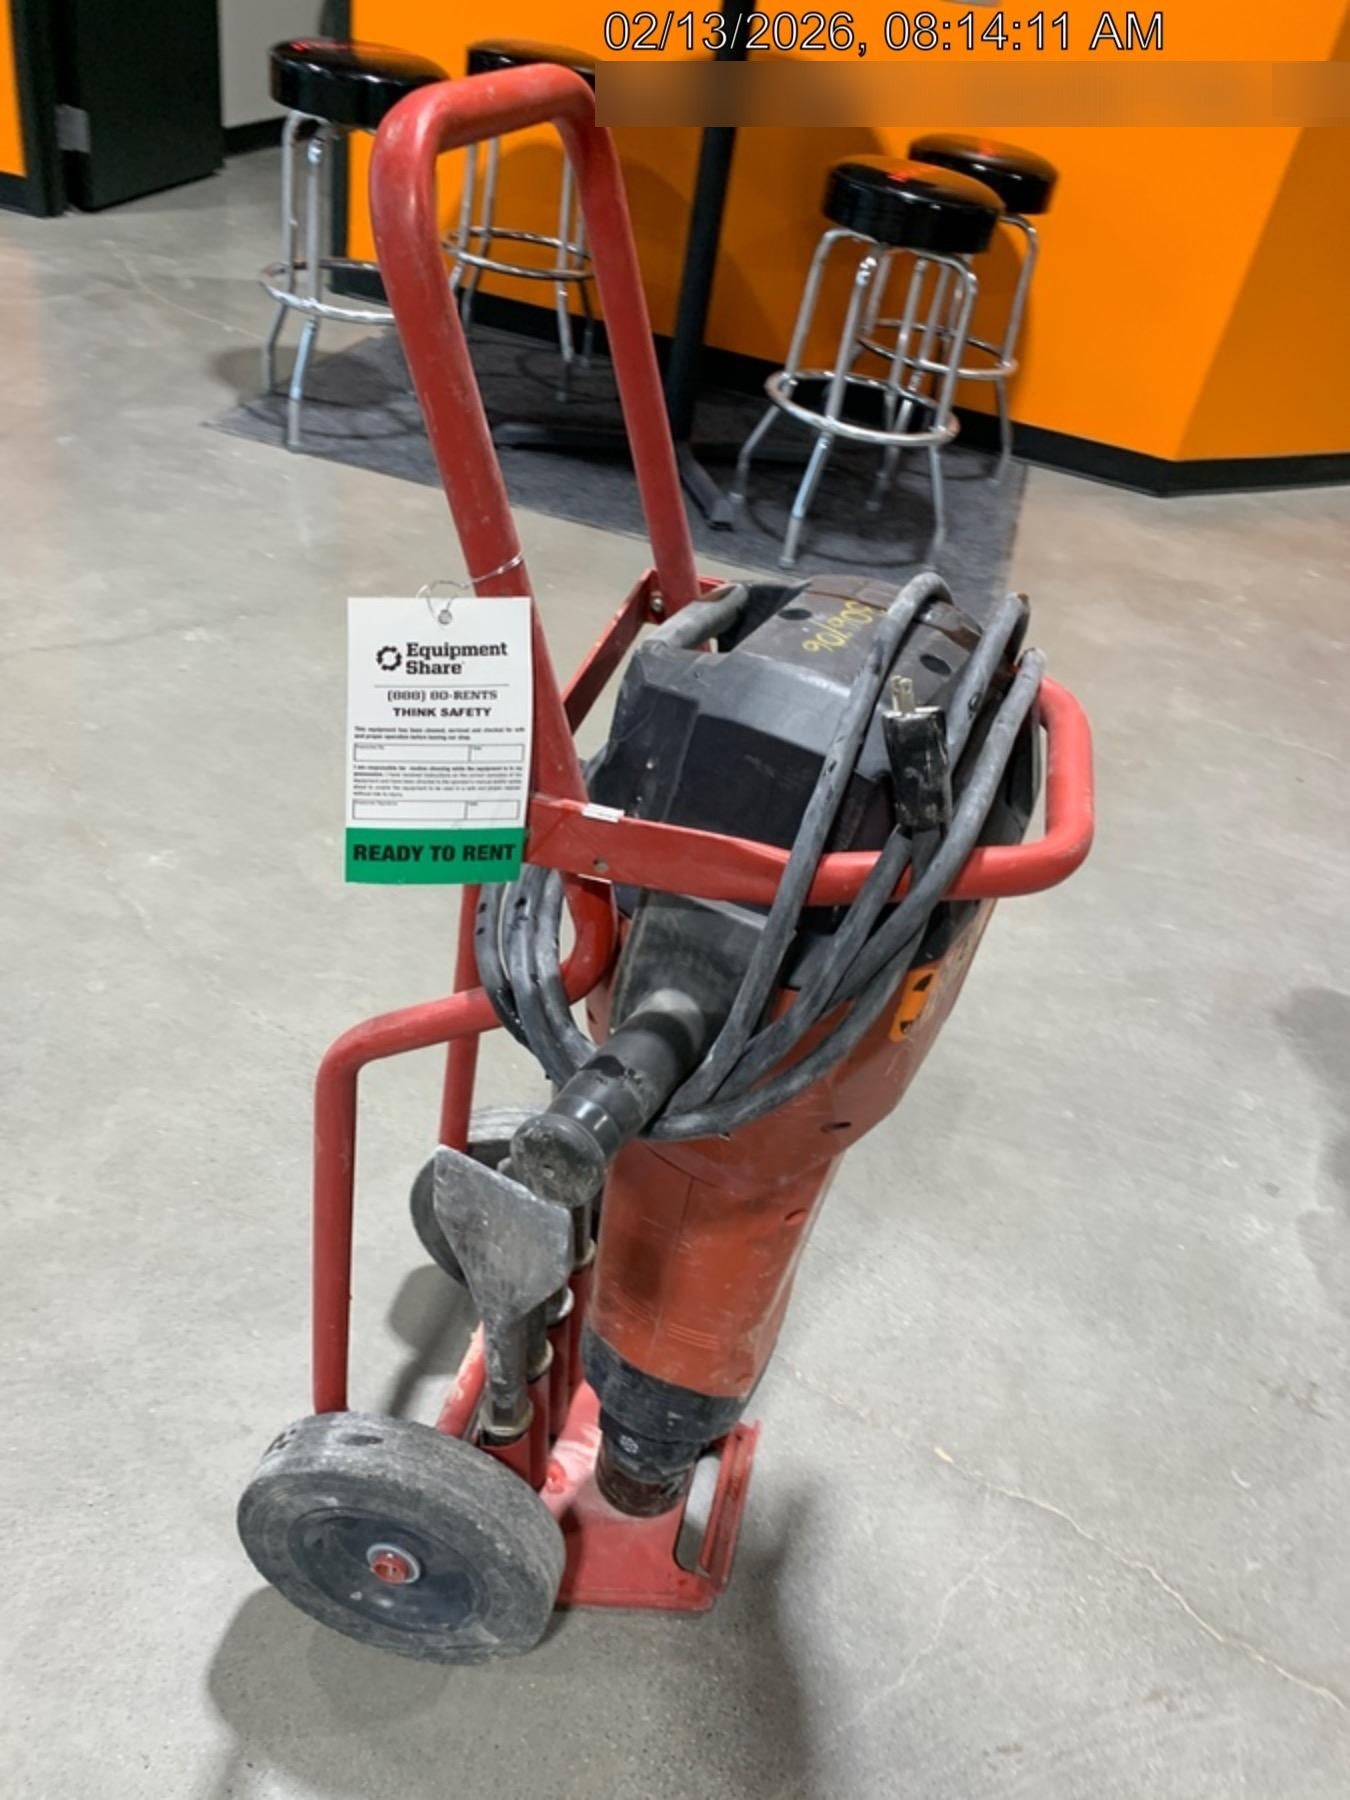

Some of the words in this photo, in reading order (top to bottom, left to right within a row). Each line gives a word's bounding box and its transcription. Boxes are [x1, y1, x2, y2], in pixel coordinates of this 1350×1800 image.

[406, 642, 508, 660] Equipment
[405, 660, 462, 675] Share
[393, 707, 436, 717] THINK
[440, 707, 492, 717] SAFETY
[353, 844, 424, 863] READY
[430, 844, 456, 862] TO
[463, 844, 517, 862] RENT
